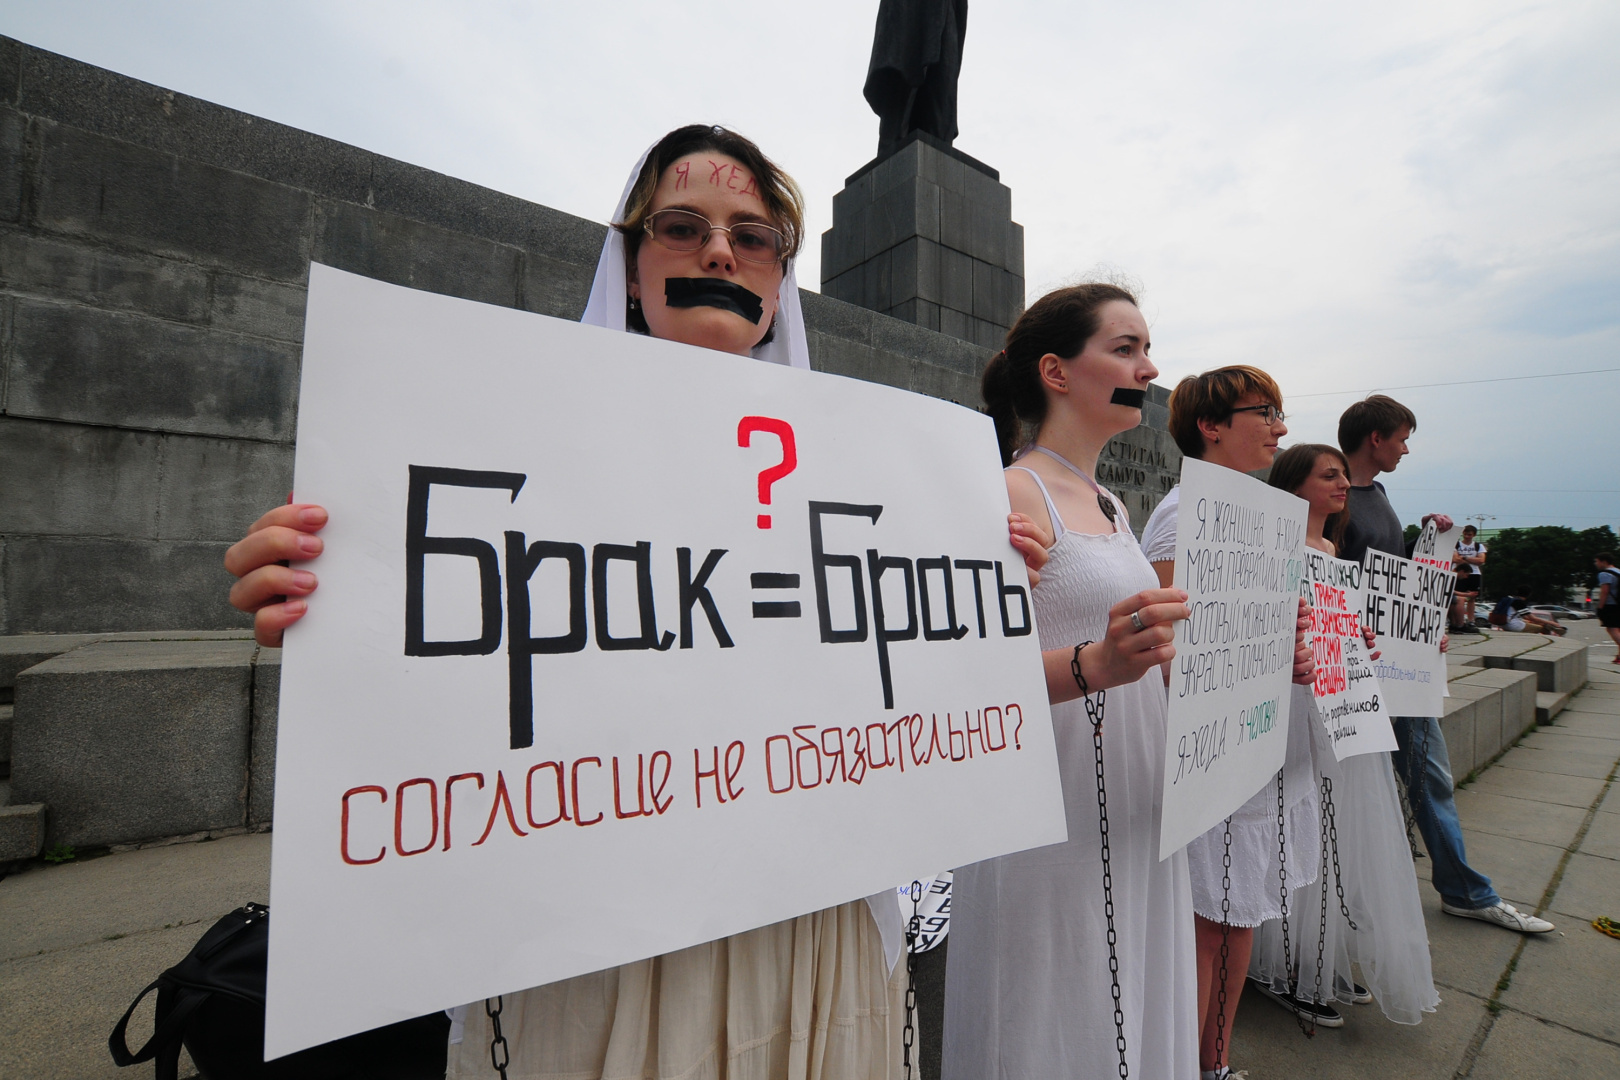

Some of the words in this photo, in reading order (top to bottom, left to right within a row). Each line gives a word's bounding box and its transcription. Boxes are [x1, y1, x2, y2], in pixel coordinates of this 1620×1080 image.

[675, 161, 690, 192] Я
[1097, 463, 1145, 486] САМУЮ
[1195, 497, 1207, 541] Я
[404, 464, 735, 750] Брак
[808, 500, 1032, 710] Брать
[1364, 552, 1408, 599] ЧЕЧНЕ
[1412, 565, 1456, 610] ЗАКОН
[1366, 593, 1387, 636] НЕ
[1390, 599, 1442, 646] ПИСАН?
[340, 750, 674, 866] согласие
[694, 740, 745, 809] не
